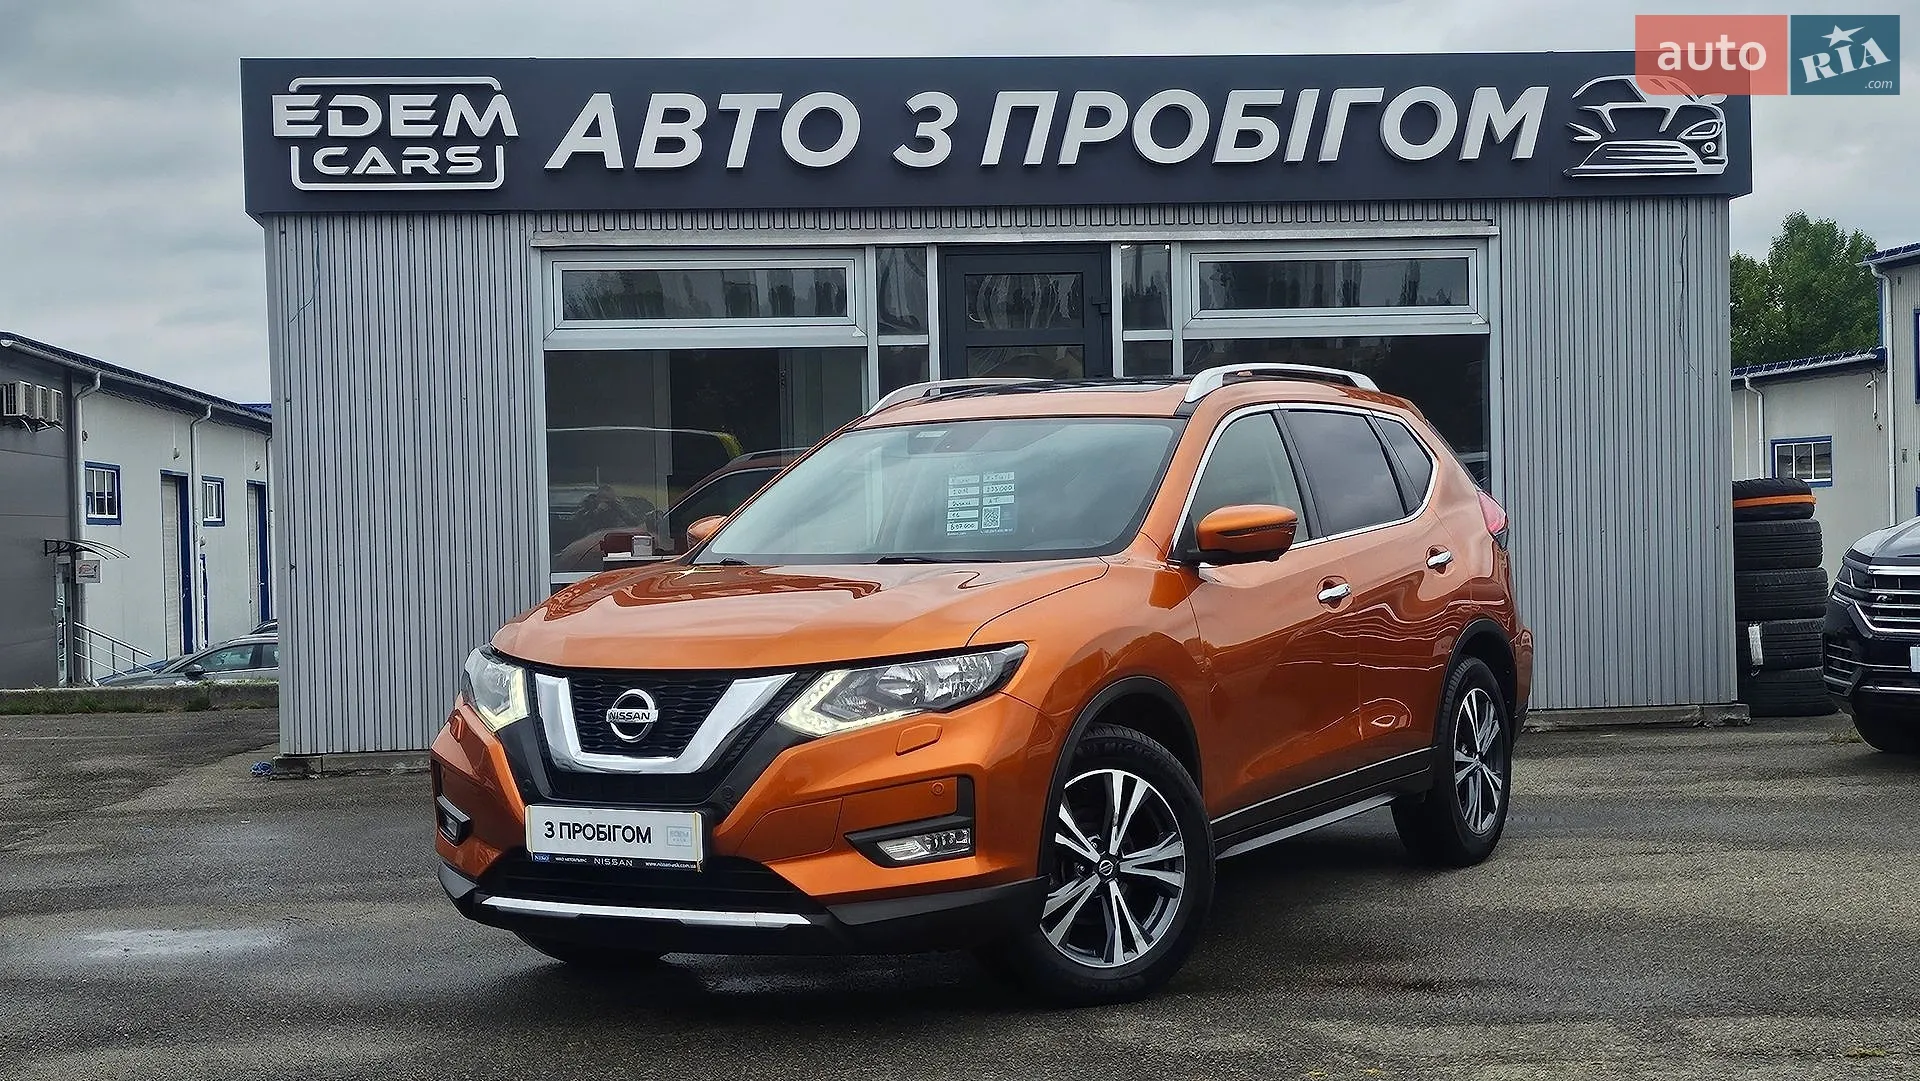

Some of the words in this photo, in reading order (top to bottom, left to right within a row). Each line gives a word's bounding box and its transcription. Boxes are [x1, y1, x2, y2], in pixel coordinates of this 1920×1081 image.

[271, 93, 519, 138] EDEM
[543, 91, 860, 169] АВТО
[891, 91, 959, 168] З
[980, 86, 1549, 166] ПРОБІГОМ
[312, 145, 483, 175] CARS
[608, 711, 651, 721] NISSAN
[544, 821, 556, 839] З
[559, 822, 652, 844] ПРОБІГОМ
[593, 857, 633, 867] NISSAN
